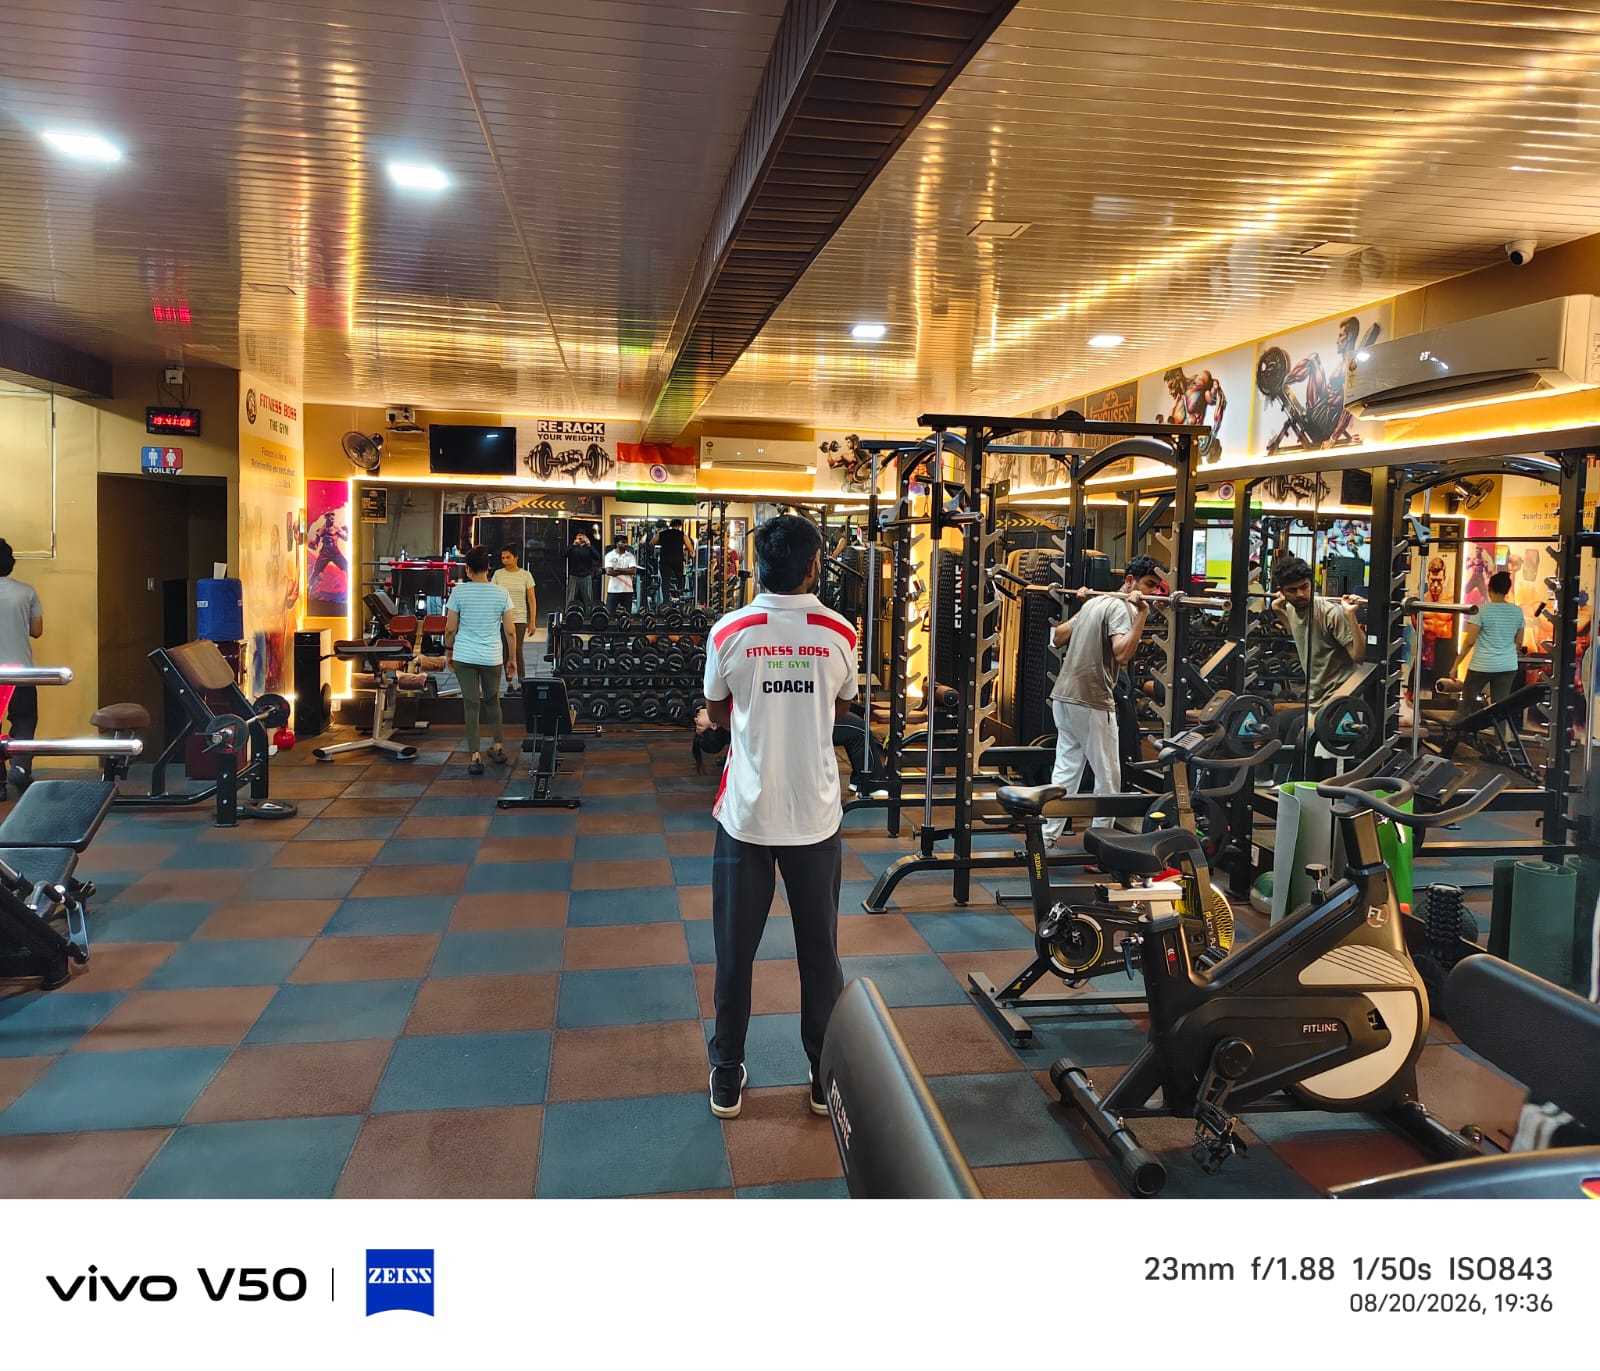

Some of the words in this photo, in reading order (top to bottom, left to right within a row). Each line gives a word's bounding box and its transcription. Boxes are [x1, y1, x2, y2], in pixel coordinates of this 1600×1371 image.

[259, 393, 281, 415] FITNESS
[537, 421, 604, 434] RE-RACK
[537, 433, 562, 441] YOUR
[564, 434, 606, 442] WEIGHTS
[745, 645, 794, 658] FITNESS
[798, 646, 831, 658] BOSS
[767, 660, 785, 669] THE
[788, 660, 811, 669] GYM
[762, 680, 815, 694] COACH
[1302, 1022, 1339, 1033] FITLINE
